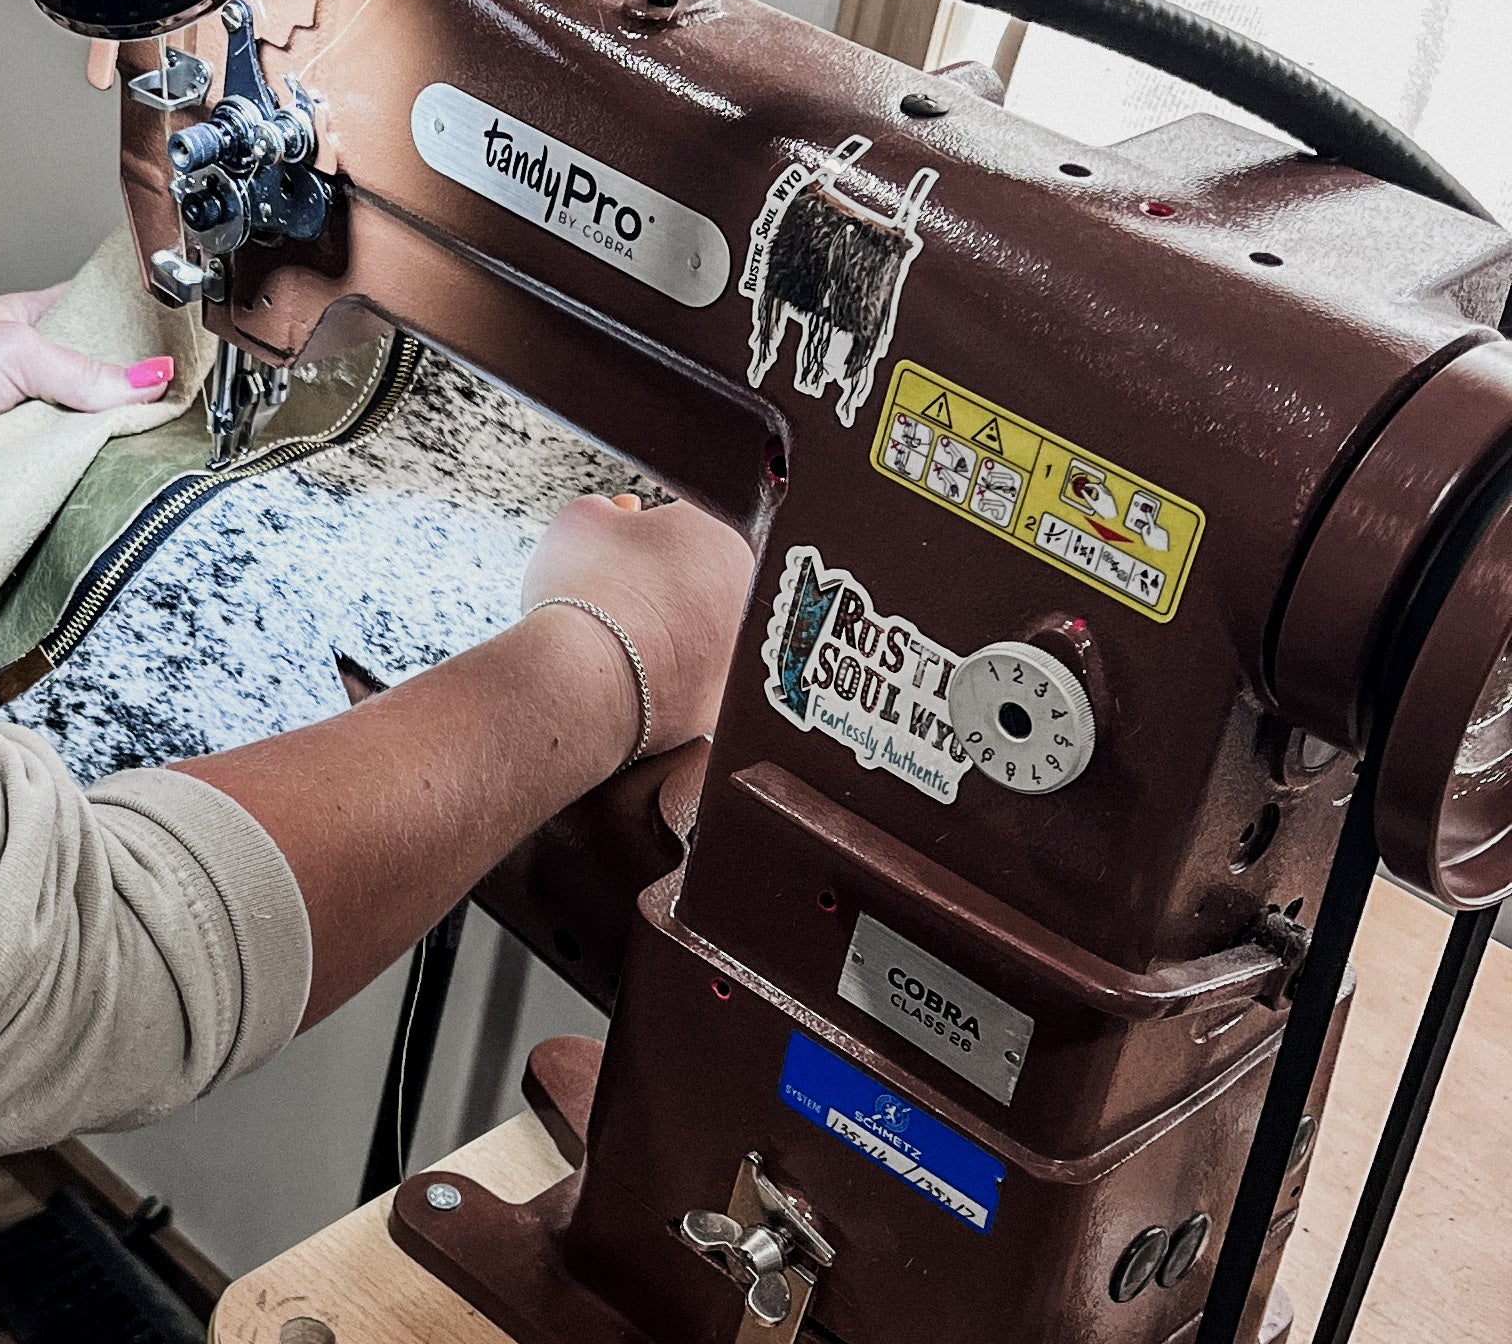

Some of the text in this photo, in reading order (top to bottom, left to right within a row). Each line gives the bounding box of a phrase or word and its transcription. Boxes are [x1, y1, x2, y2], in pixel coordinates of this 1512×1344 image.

[484, 118, 643, 241] tandyPro
[558, 211, 634, 261] BY COBRA
[744, 170, 802, 292] RUSTIC SOUL WYO
[1045, 464, 1053, 479] 1
[1024, 516, 1037, 532] 2
[831, 587, 956, 700] RUSTI
[812, 642, 901, 724] SOUL
[812, 694, 950, 795] Fearlessly Authentic
[888, 967, 980, 1041] COBRA
[890, 993, 972, 1052] CLASS 26
[854, 1111, 923, 1160] SCHMETZ
